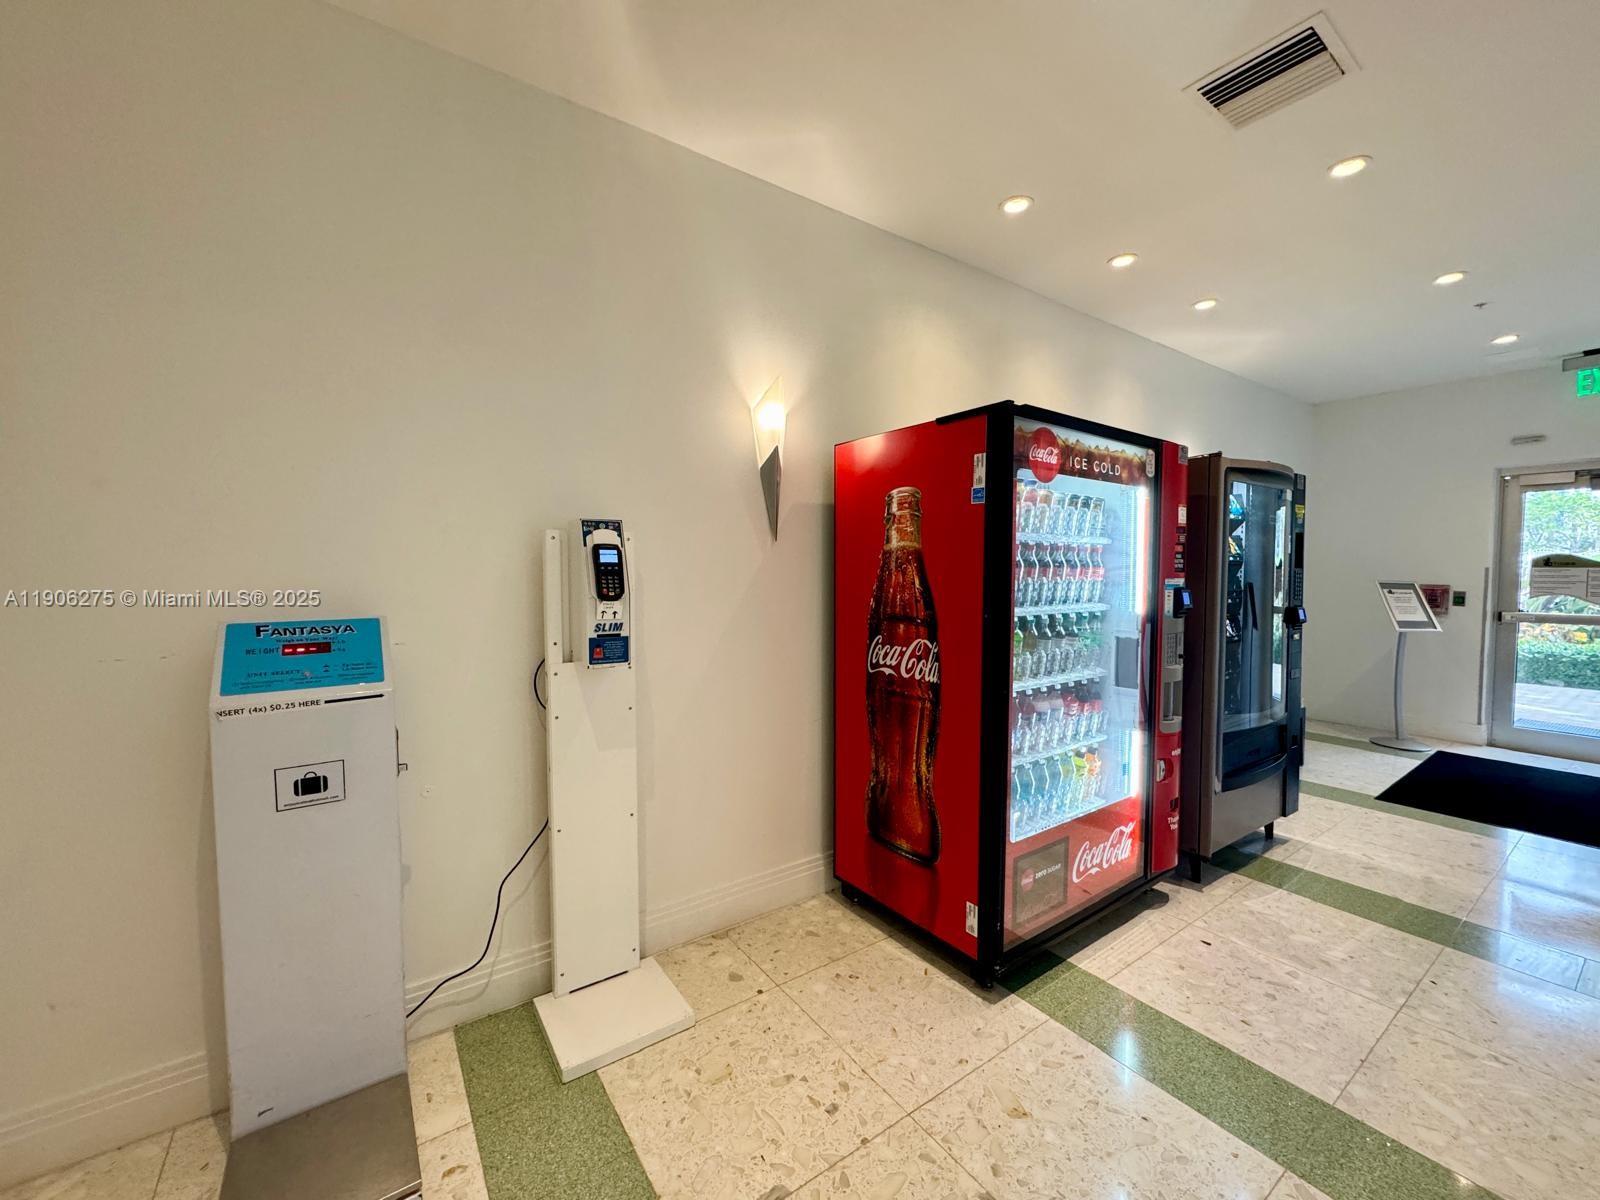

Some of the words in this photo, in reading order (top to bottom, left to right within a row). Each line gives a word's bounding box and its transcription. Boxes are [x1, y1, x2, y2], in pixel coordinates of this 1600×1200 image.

[1069, 456, 1088, 470] ICE
[1093, 461, 1121, 476] COLD
[594, 622, 624, 633] SLIM
[245, 647, 280, 656] WEIGHT
[867, 635, 940, 683] Coca-Cola
[216, 708, 245, 717] NSERT
[249, 706, 267, 715] (4x)
[270, 702, 296, 711] $0.25
[299, 699, 321, 708] HERE
[1072, 820, 1137, 883] Coca-Cola
